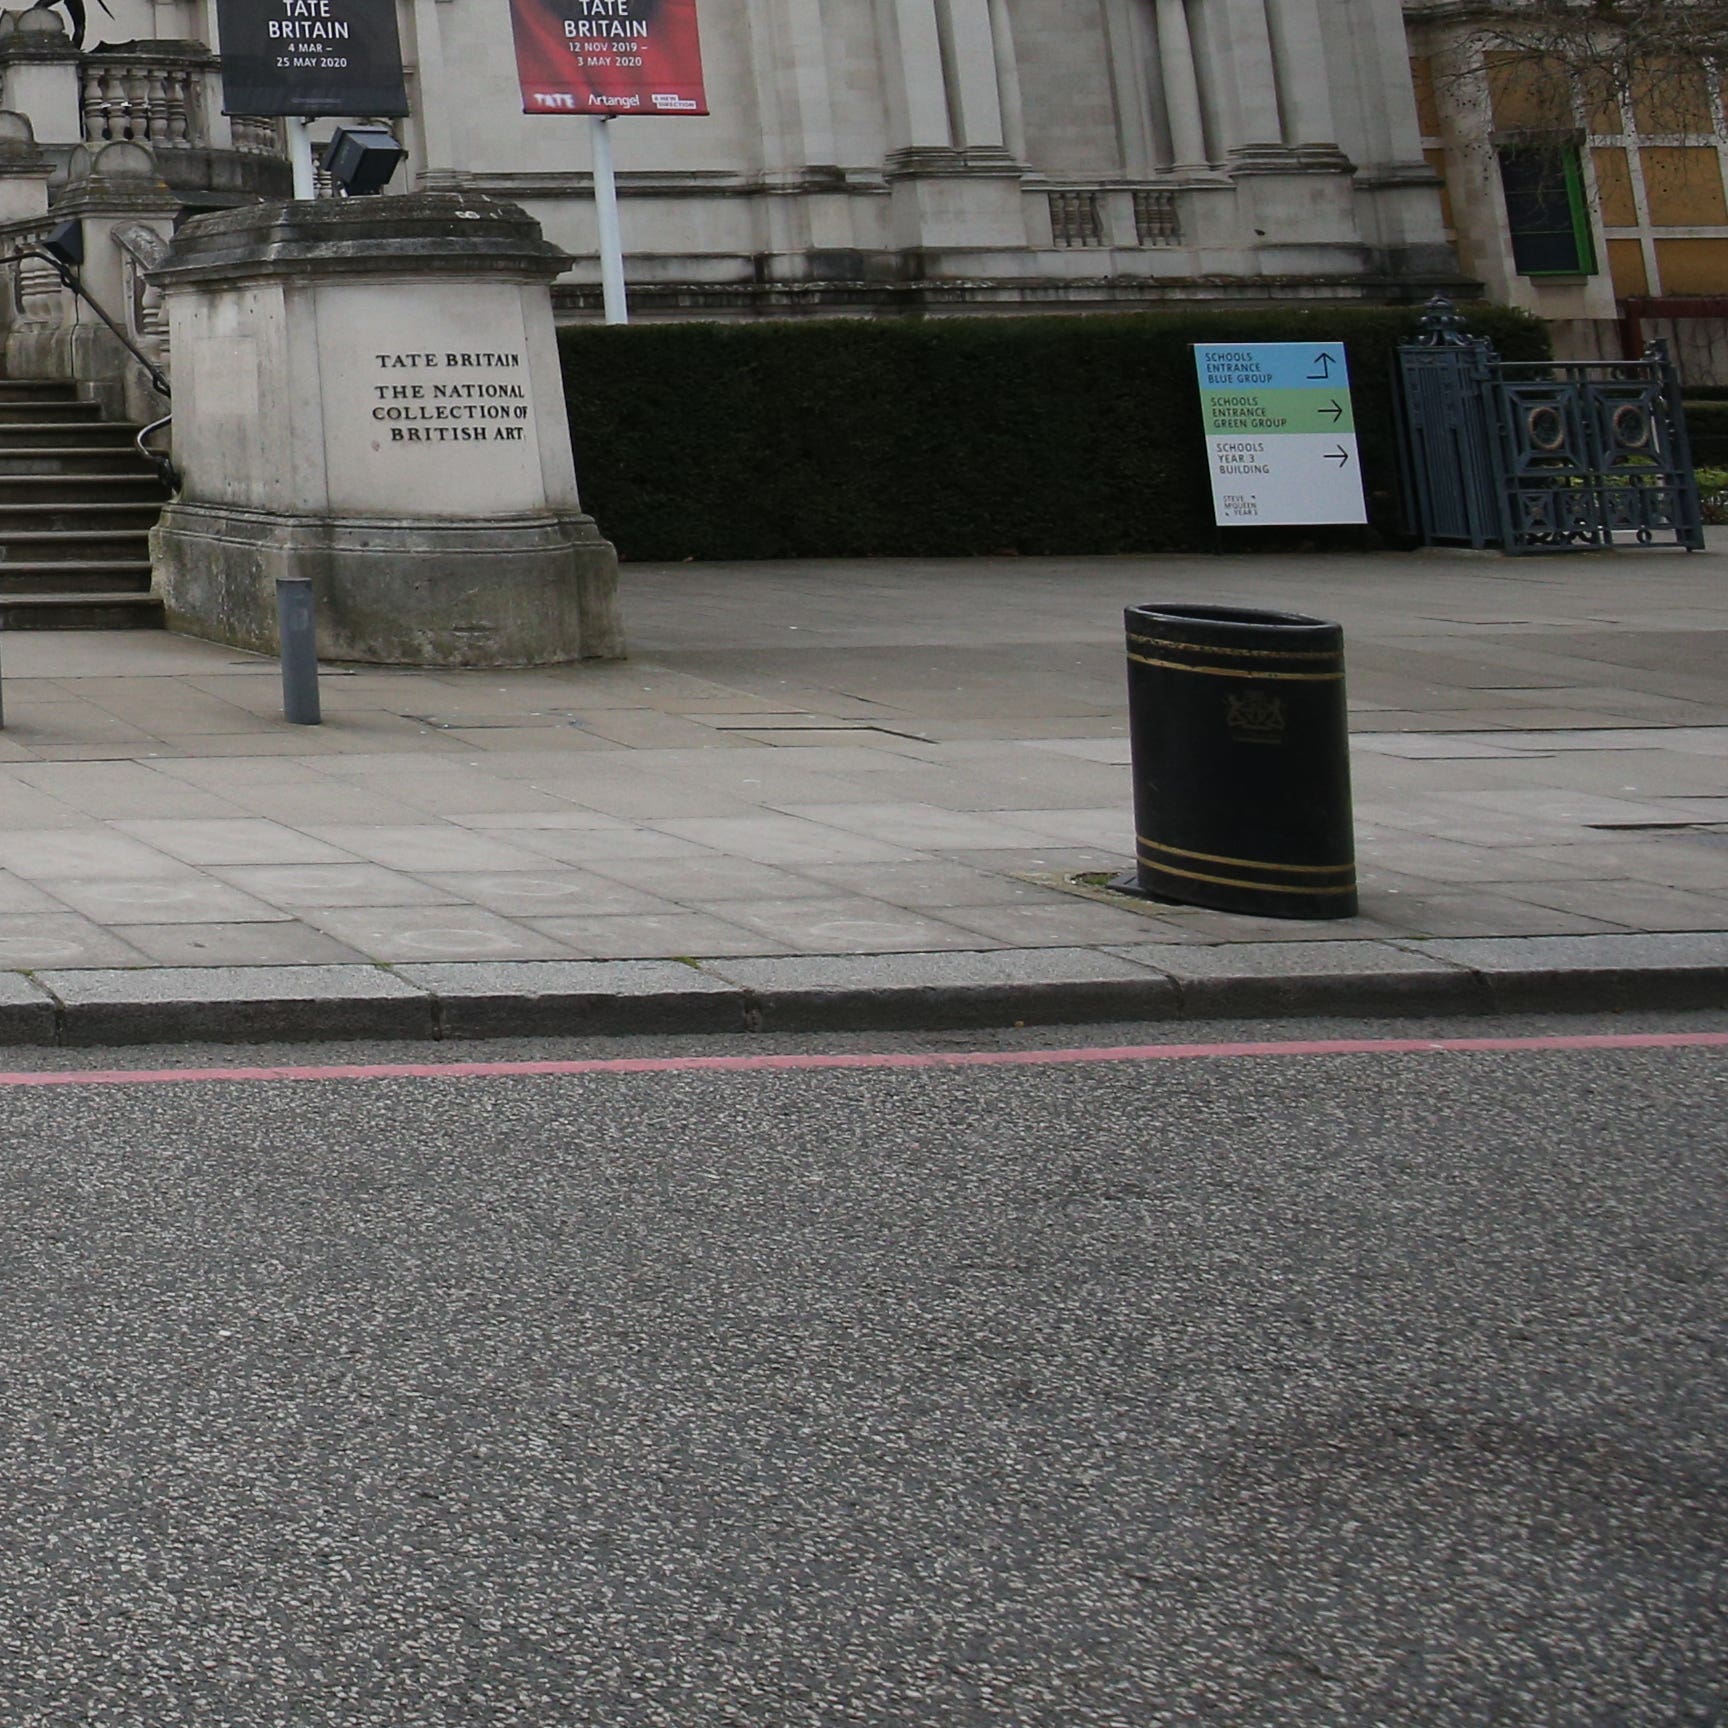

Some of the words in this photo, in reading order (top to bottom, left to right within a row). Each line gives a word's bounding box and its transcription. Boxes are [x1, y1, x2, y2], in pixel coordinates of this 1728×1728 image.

[283, 0, 331, 17] TATE
[268, 20, 349, 39] BRITAIN
[564, 20, 648, 38] BRITAIN
[288, 43, 295, 52] 4
[299, 43, 323, 52] MAR
[569, 42, 581, 52] 12
[584, 42, 608, 52] NOV
[612, 42, 637, 52] 2019
[276, 57, 290, 67] 25
[293, 57, 317, 67] MAY
[320, 57, 347, 68] 2020
[578, 57, 583, 66] 3
[587, 57, 611, 66] MAY
[615, 57, 642, 66] 2020
[534, 93, 576, 108] TATE
[588, 94, 640, 108] Artangel
[375, 354, 438, 368] TATE
[446, 353, 519, 367] BRITAIN
[1205, 352, 1252, 362] SCHOOLS
[1206, 363, 1261, 373] ENTRANCE
[1208, 374, 1233, 384] BLUE
[1237, 374, 1272, 384] GROUP
[374, 385, 424, 399] THE
[433, 384, 525, 398] NATIONAL
[1210, 397, 1258, 406] SCHOOLS
[372, 405, 510, 420] COLLECTION
[514, 406, 528, 419] OF
[1212, 407, 1266, 417] ENTRANCE
[1213, 419, 1247, 428] GREEN
[1251, 418, 1287, 428] GROUP
[390, 427, 486, 441] BRITISH
[494, 427, 524, 440] ART
[1216, 443, 1264, 452] SCHOOLS
[1218, 454, 1244, 463] YEAR
[1249, 454, 1255, 463] 3
[1219, 464, 1270, 474] BUILDING
